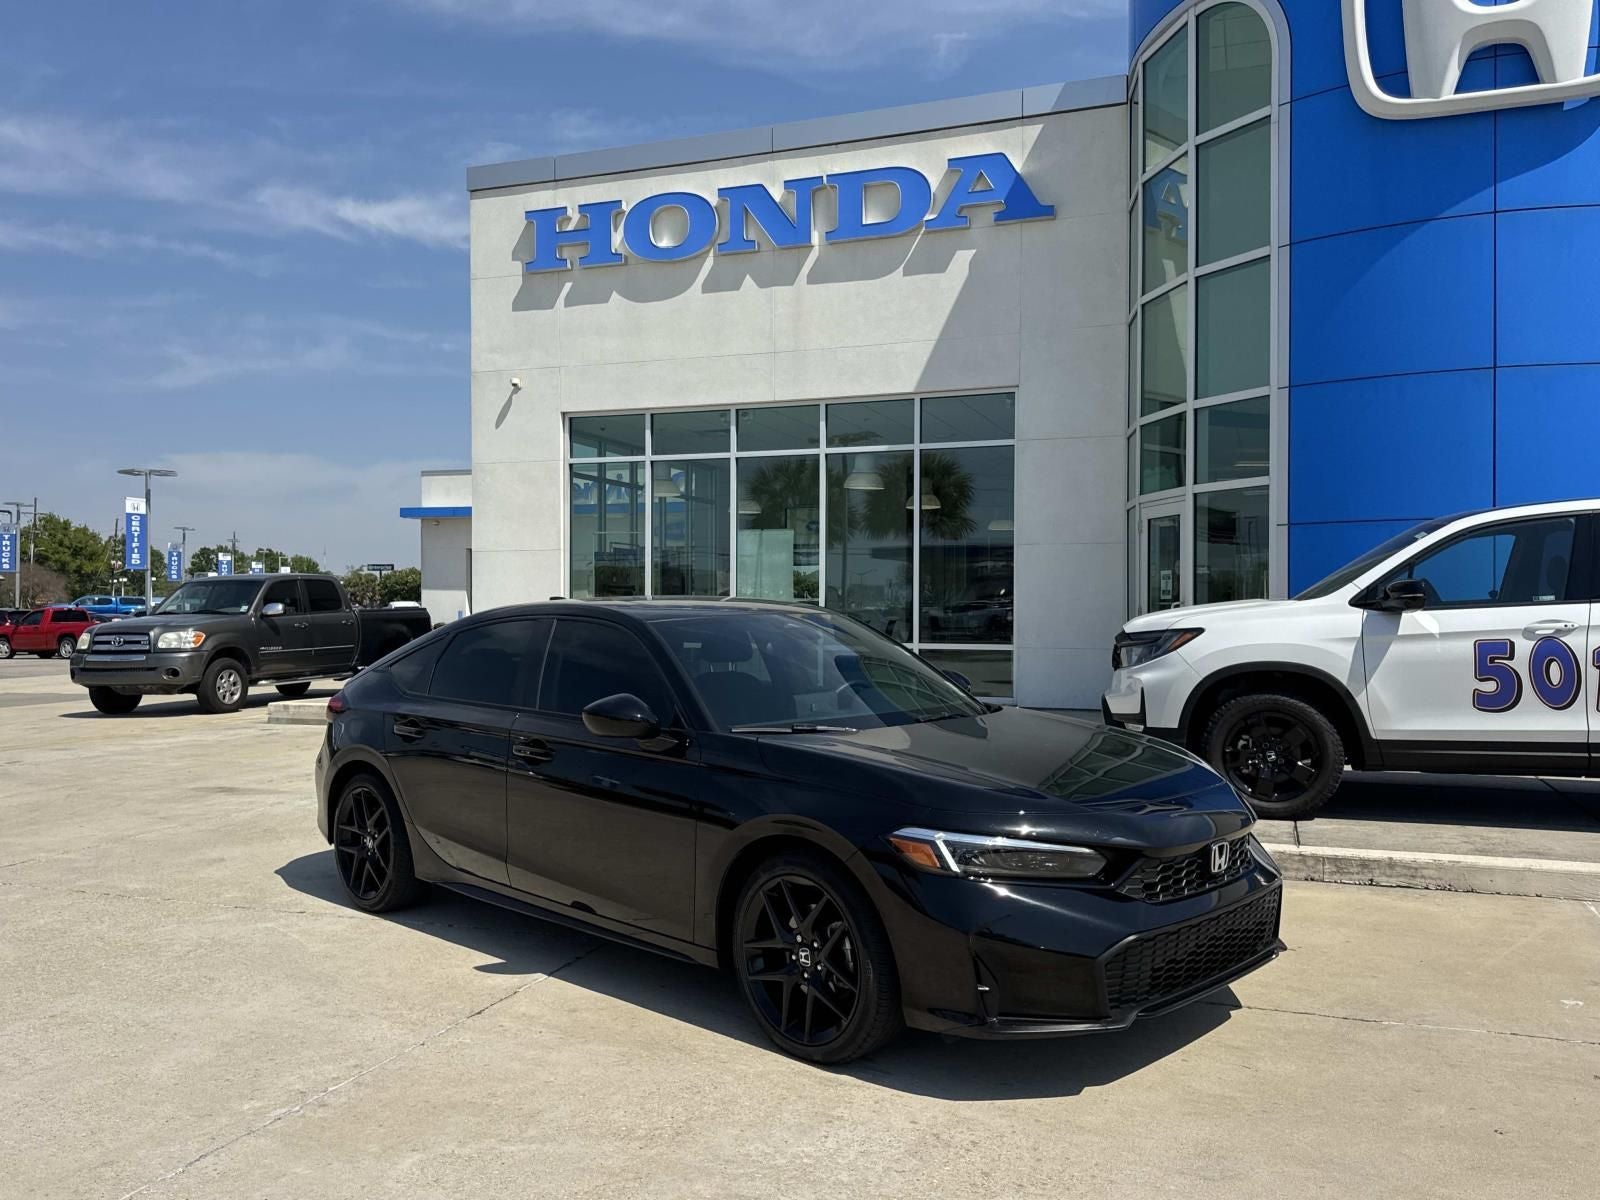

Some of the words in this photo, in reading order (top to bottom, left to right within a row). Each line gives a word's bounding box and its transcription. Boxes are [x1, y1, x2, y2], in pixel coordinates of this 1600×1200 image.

[525, 152, 1056, 274] HONDA
[2, 534, 11, 569] TRUCKS
[131, 515, 141, 565] CERTIFIED
